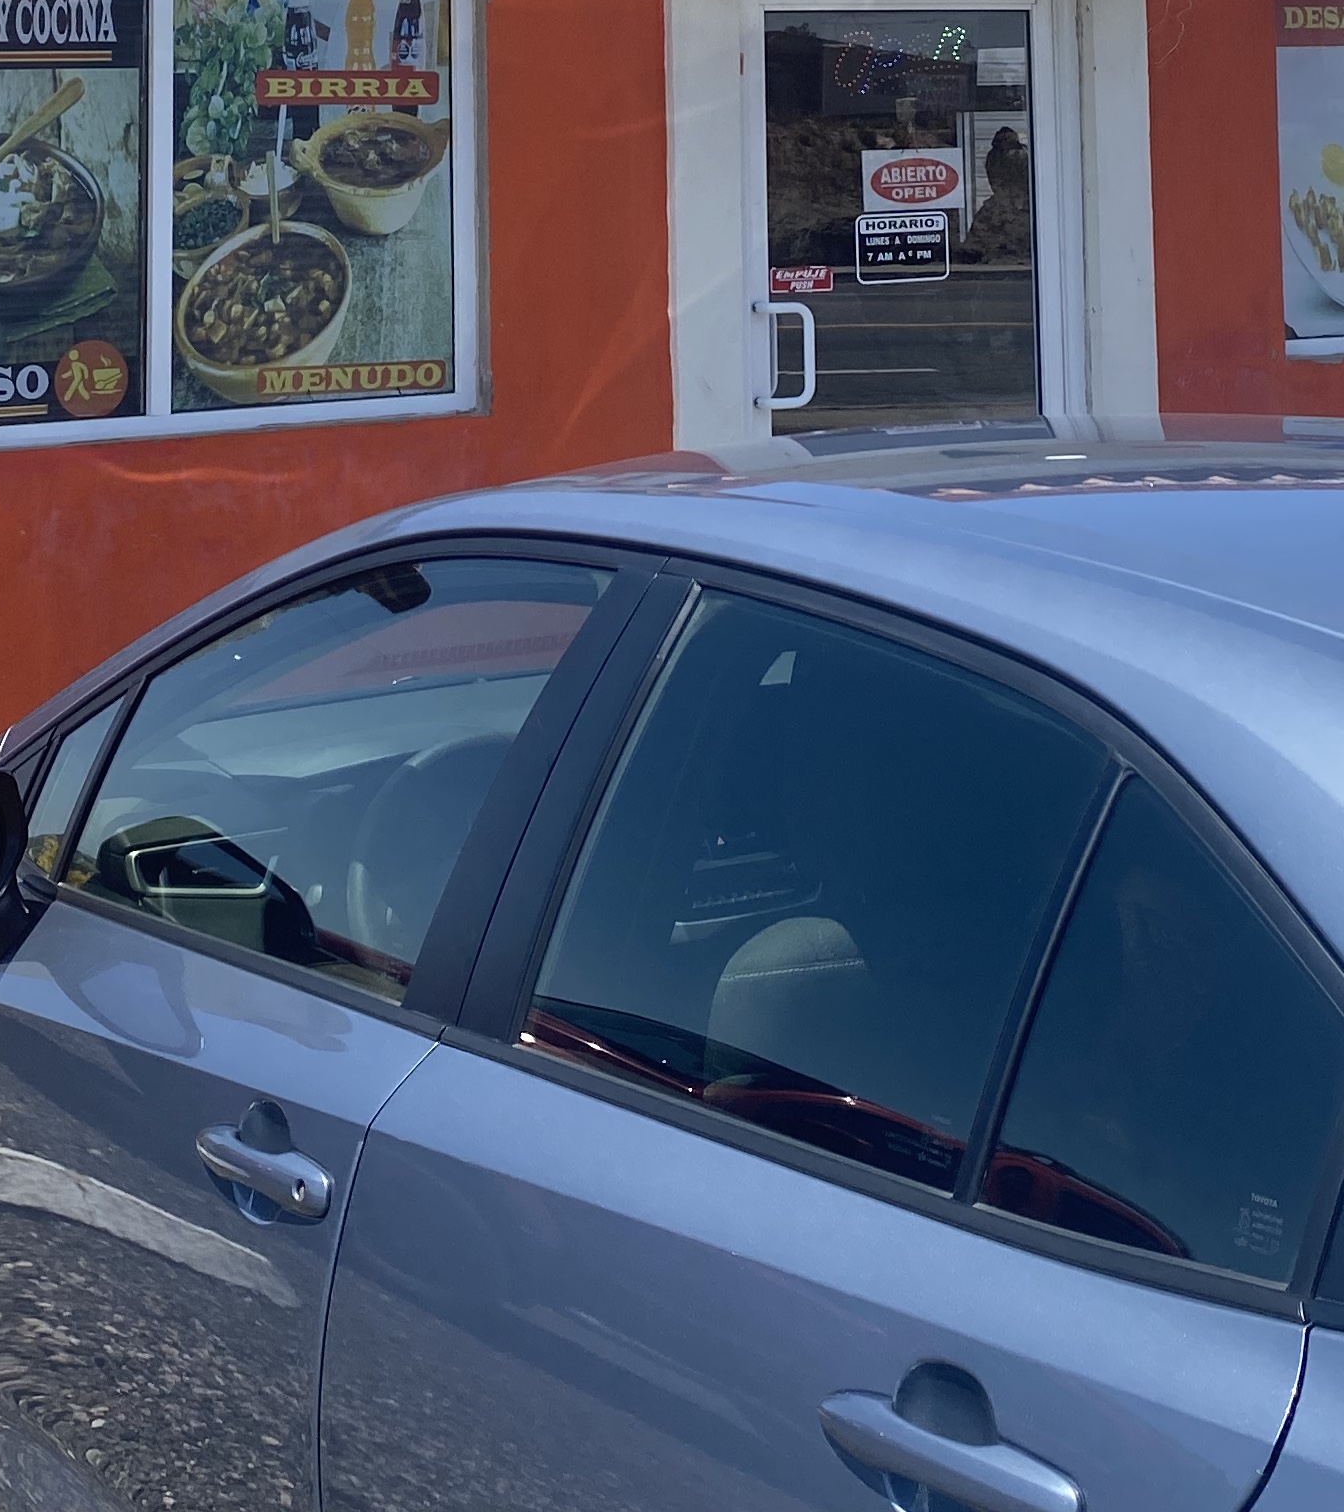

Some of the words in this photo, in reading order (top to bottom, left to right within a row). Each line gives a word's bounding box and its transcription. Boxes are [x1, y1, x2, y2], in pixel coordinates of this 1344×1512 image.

[264, 77, 432, 98] BIRRIA
[880, 165, 947, 183] ABIERTO
[891, 186, 937, 199] OPEN
[866, 236, 890, 246] LUNES
[894, 235, 901, 245] A
[907, 234, 941, 244] DOMINGO
[867, 252, 873, 261] 7
[877, 252, 893, 262] AM
[898, 251, 906, 261] A
[916, 250, 932, 259] PM
[775, 268, 828, 279] EMPUJE
[790, 279, 814, 290] PUSH
[260, 363, 442, 395] MENUDO
